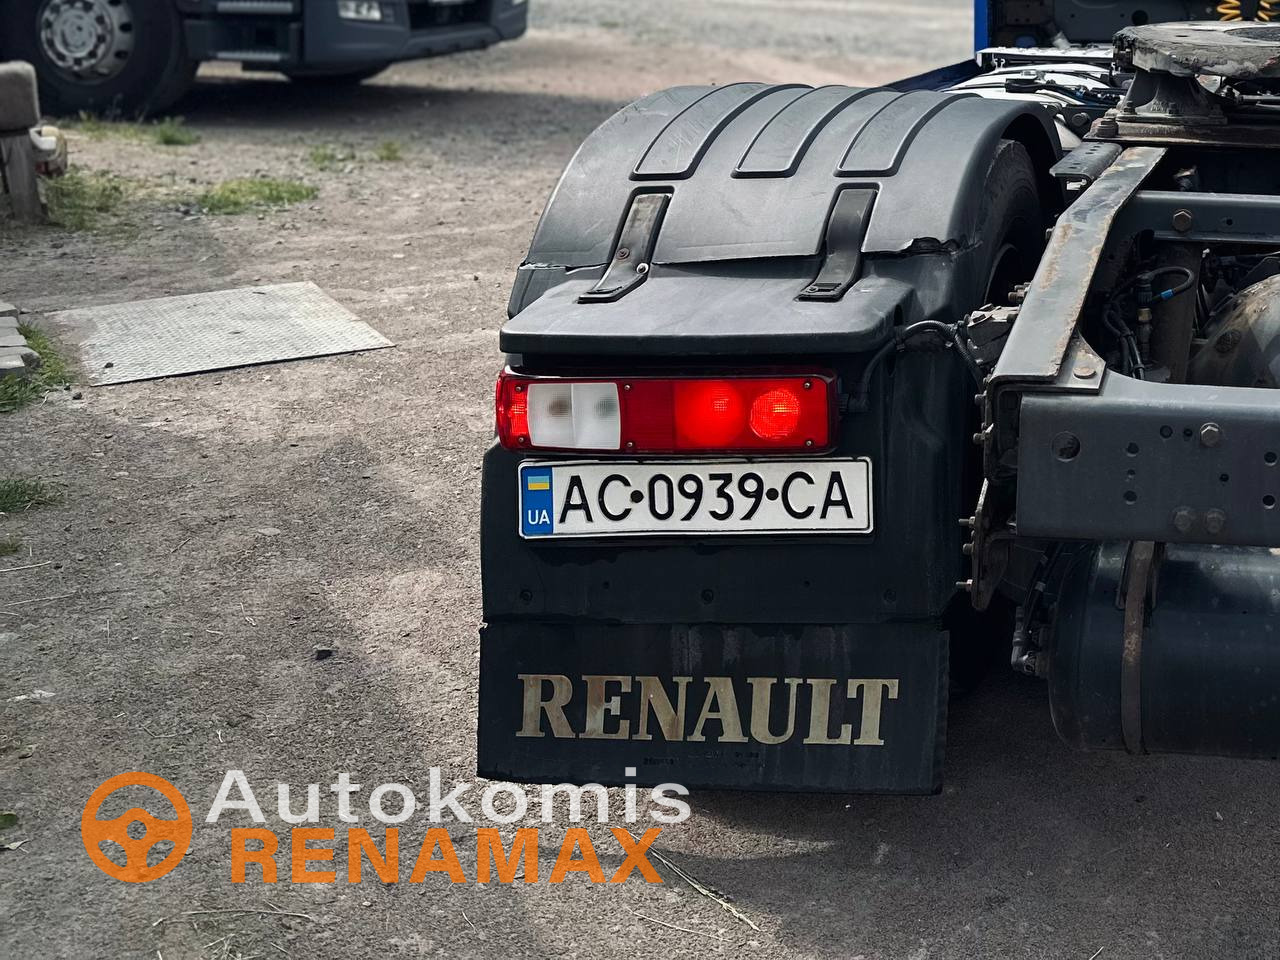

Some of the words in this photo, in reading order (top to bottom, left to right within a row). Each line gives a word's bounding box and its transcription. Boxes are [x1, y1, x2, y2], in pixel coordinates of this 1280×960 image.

[528, 509, 551, 525] UA
[559, 474, 632, 523] AC
[649, 472, 764, 521] 0939
[781, 471, 853, 519] CA
[515, 673, 900, 746] RENAULT
